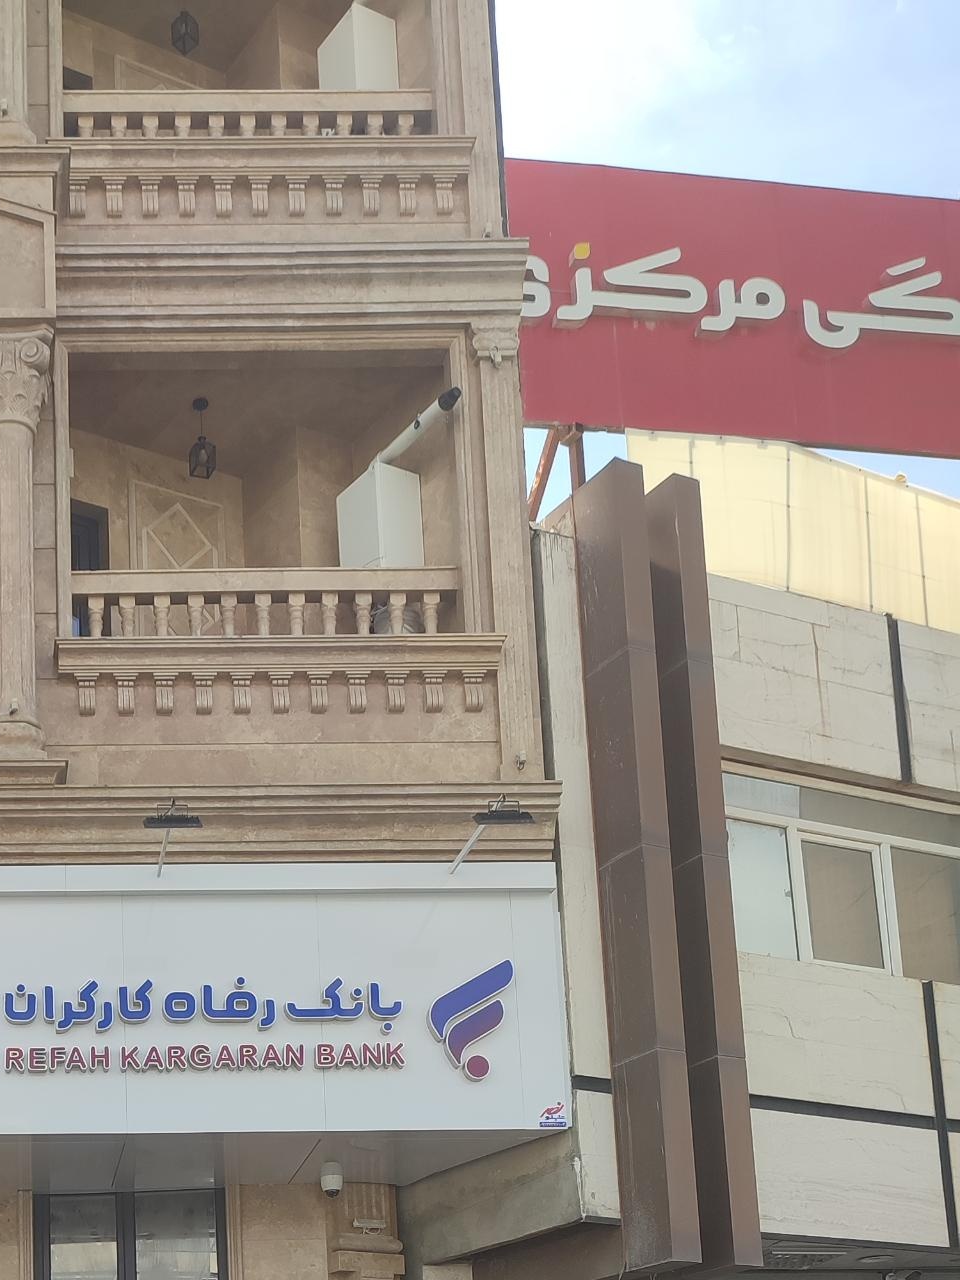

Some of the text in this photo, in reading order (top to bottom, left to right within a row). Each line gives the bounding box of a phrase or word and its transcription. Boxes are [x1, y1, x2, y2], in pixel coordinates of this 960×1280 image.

[3, 975, 404, 1035] بانک رفاه کارگران
[4, 1041, 406, 1072] REFAH KARGARAN BANK
